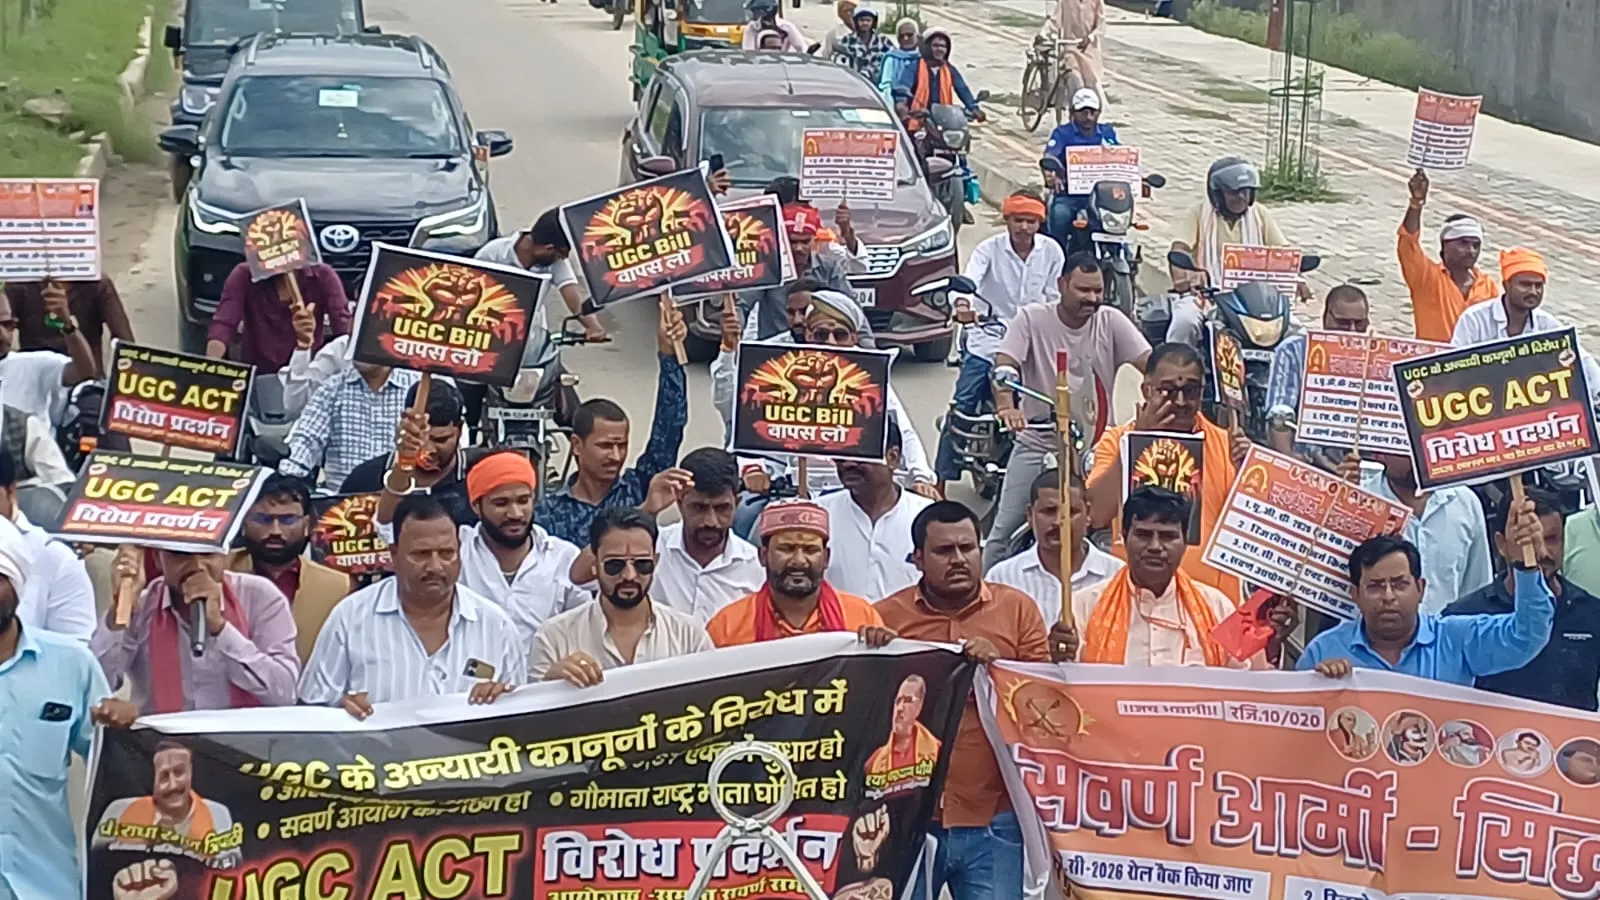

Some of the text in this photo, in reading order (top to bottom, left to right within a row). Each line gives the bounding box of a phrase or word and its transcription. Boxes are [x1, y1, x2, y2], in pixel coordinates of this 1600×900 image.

[606, 231, 692, 270] UGC Bill
[616, 249, 691, 283] वापस लो
[735, 251, 757, 265] ill
[393, 316, 492, 350] UGC Bill
[393, 337, 483, 367] वापस लो
[118, 372, 239, 413] UGC ACT
[1415, 369, 1572, 427] UGC ACT
[113, 399, 168, 427] विरोध
[170, 414, 231, 439] प्रदर्शन
[765, 405, 853, 425] UGC Bill
[767, 424, 849, 442] वापस लो
[1426, 430, 1496, 464] विरोध
[1499, 411, 1581, 449] प्रदर्शन
[84, 476, 238, 508] UGC ACT
[332, 538, 371, 554] UGC
[1229, 702, 1321, 729] रजि.10/020
[337, 754, 375, 792] के
[383, 736, 522, 790] अन्यायी
[526, 713, 659, 772] कानूनों
[663, 705, 705, 742] के
[709, 687, 808, 734] विरोध
[812, 678, 849, 715] में
[818, 729, 845, 762] हो
[569, 780, 651, 811] गौमाता
[651, 784, 697, 813] राष्ट्र
[820, 769, 848, 801] हो
[1014, 743, 1204, 845] सवर्ण
[1212, 766, 1399, 874] आर्मी
[279, 801, 337, 839] सवर्ण
[336, 802, 411, 831] आयोग
[208, 851, 352, 900] UGC
[370, 832, 522, 900] ACT
[542, 828, 682, 884] विरोध
[1127, 859, 1152, 882] रोल
[1156, 862, 1182, 885] बैक
[1184, 866, 1221, 890] किया
[1222, 873, 1254, 895] जाए
